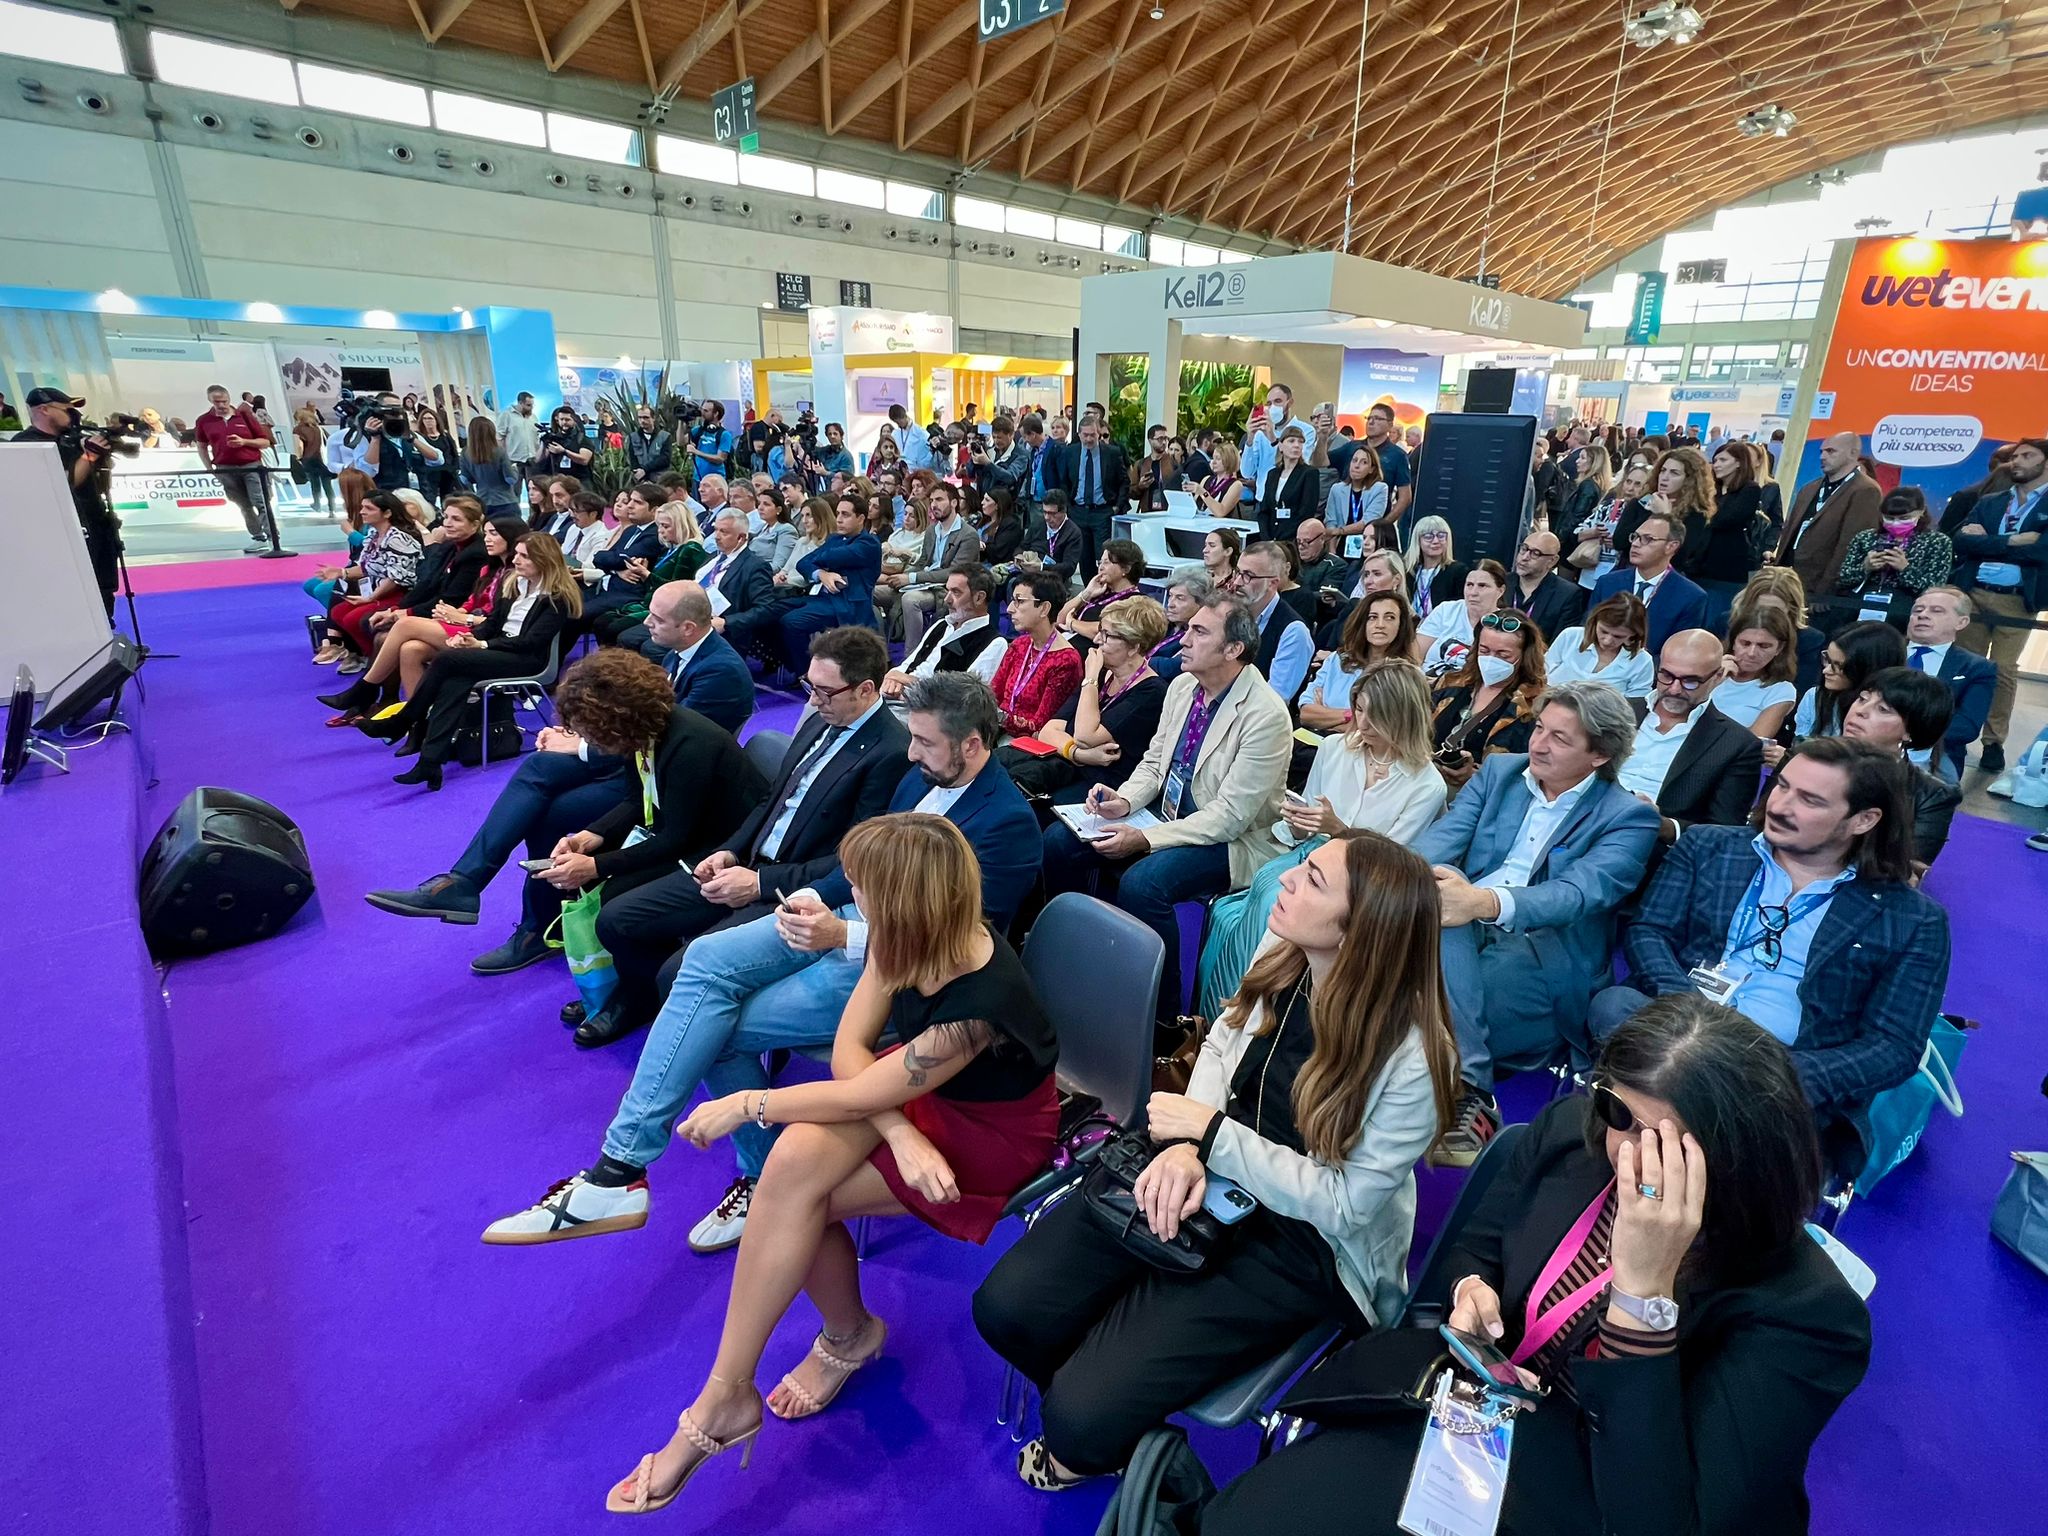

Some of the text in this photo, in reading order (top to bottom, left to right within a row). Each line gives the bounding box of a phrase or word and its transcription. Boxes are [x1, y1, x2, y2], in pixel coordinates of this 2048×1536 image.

[714, 105, 731, 141] C3
[744, 109, 750, 130] 1
[348, 354, 420, 365] SILVERSEA
[1846, 348, 2048, 371] UNCONVENTIONAL
[1909, 373, 1975, 393] IDEAS
[1878, 424, 1975, 439] Più competenza,
[1878, 439, 1965, 453] più successo.
[149, 489, 225, 501] Organizzato
